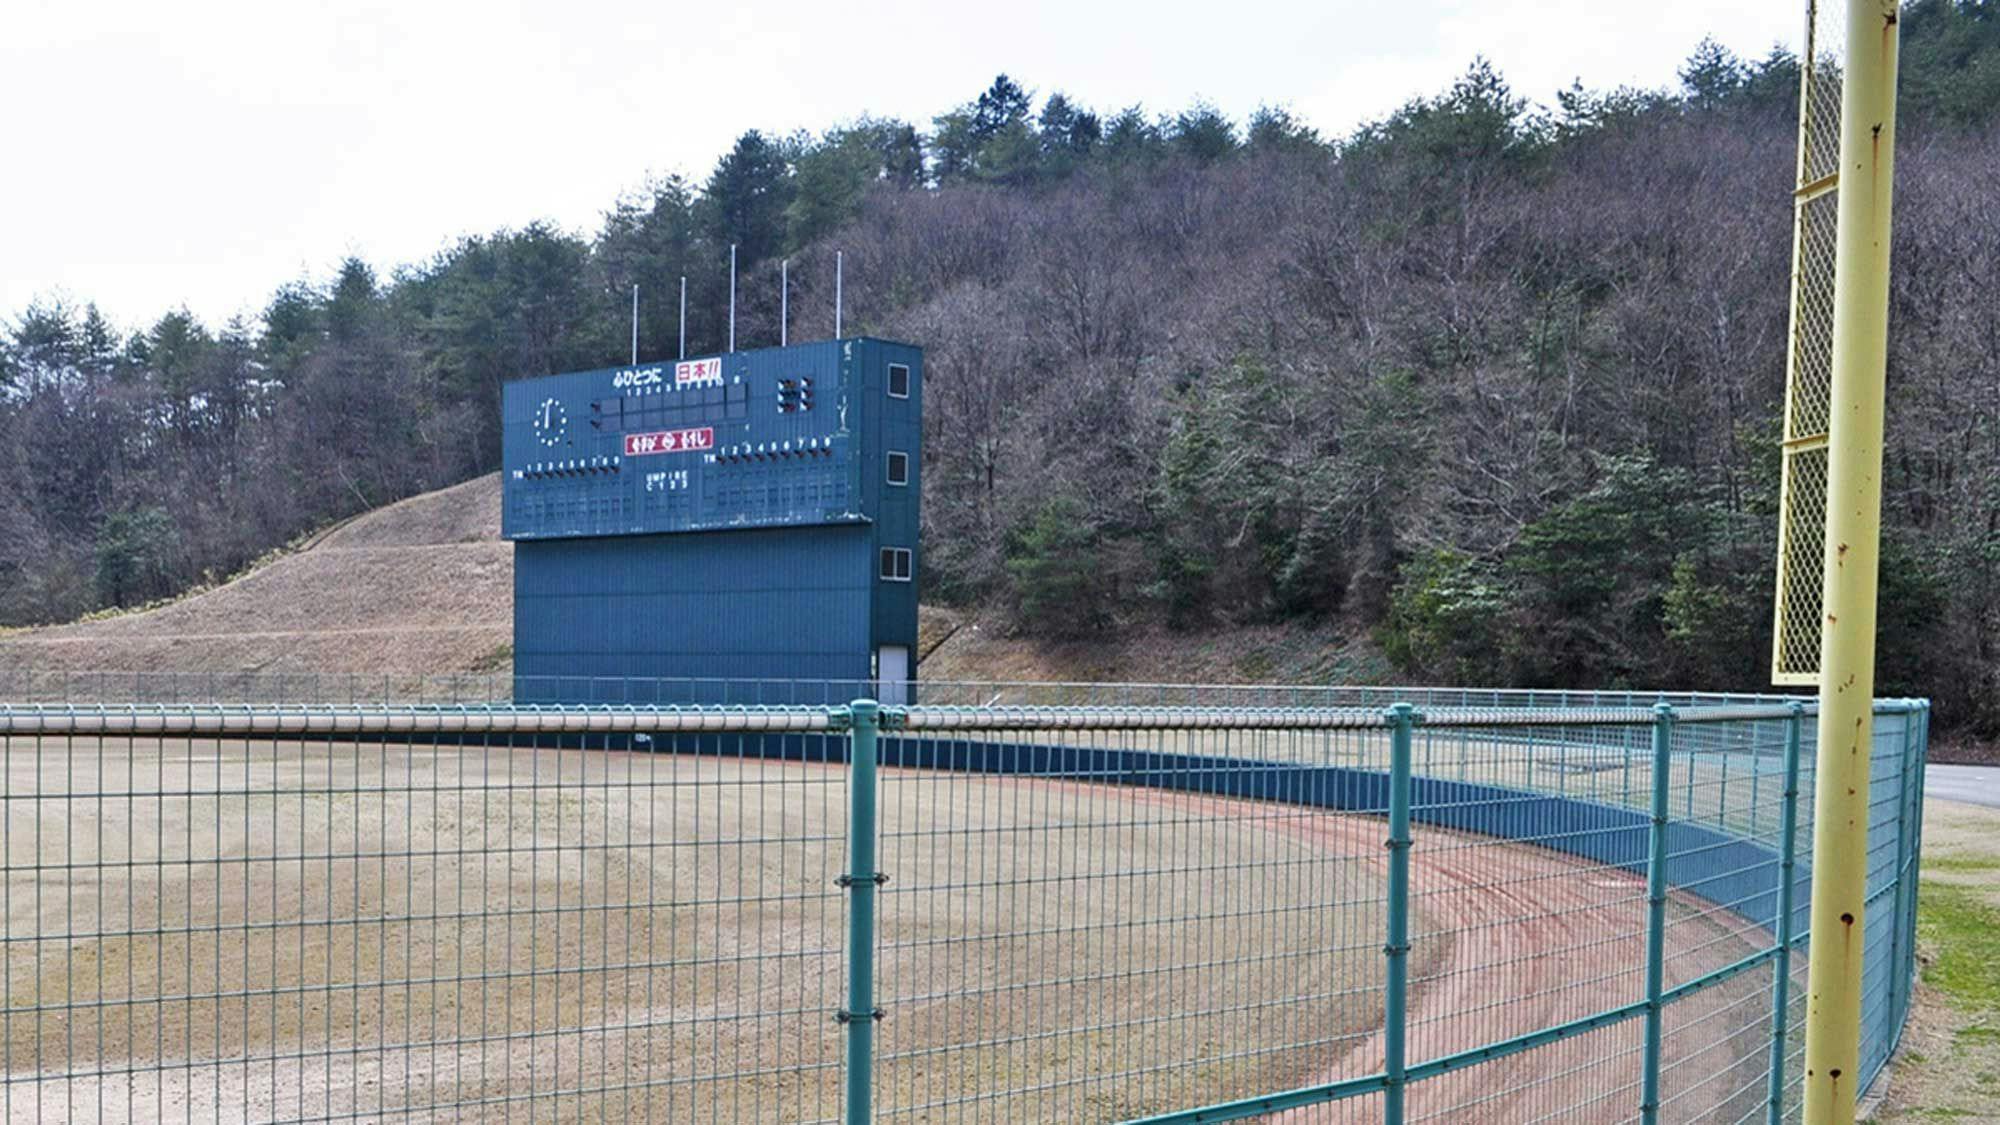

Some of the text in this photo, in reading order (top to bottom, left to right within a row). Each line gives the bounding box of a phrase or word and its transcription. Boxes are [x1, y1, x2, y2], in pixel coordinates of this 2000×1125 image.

[613, 367, 662, 388] 心ひとつに
